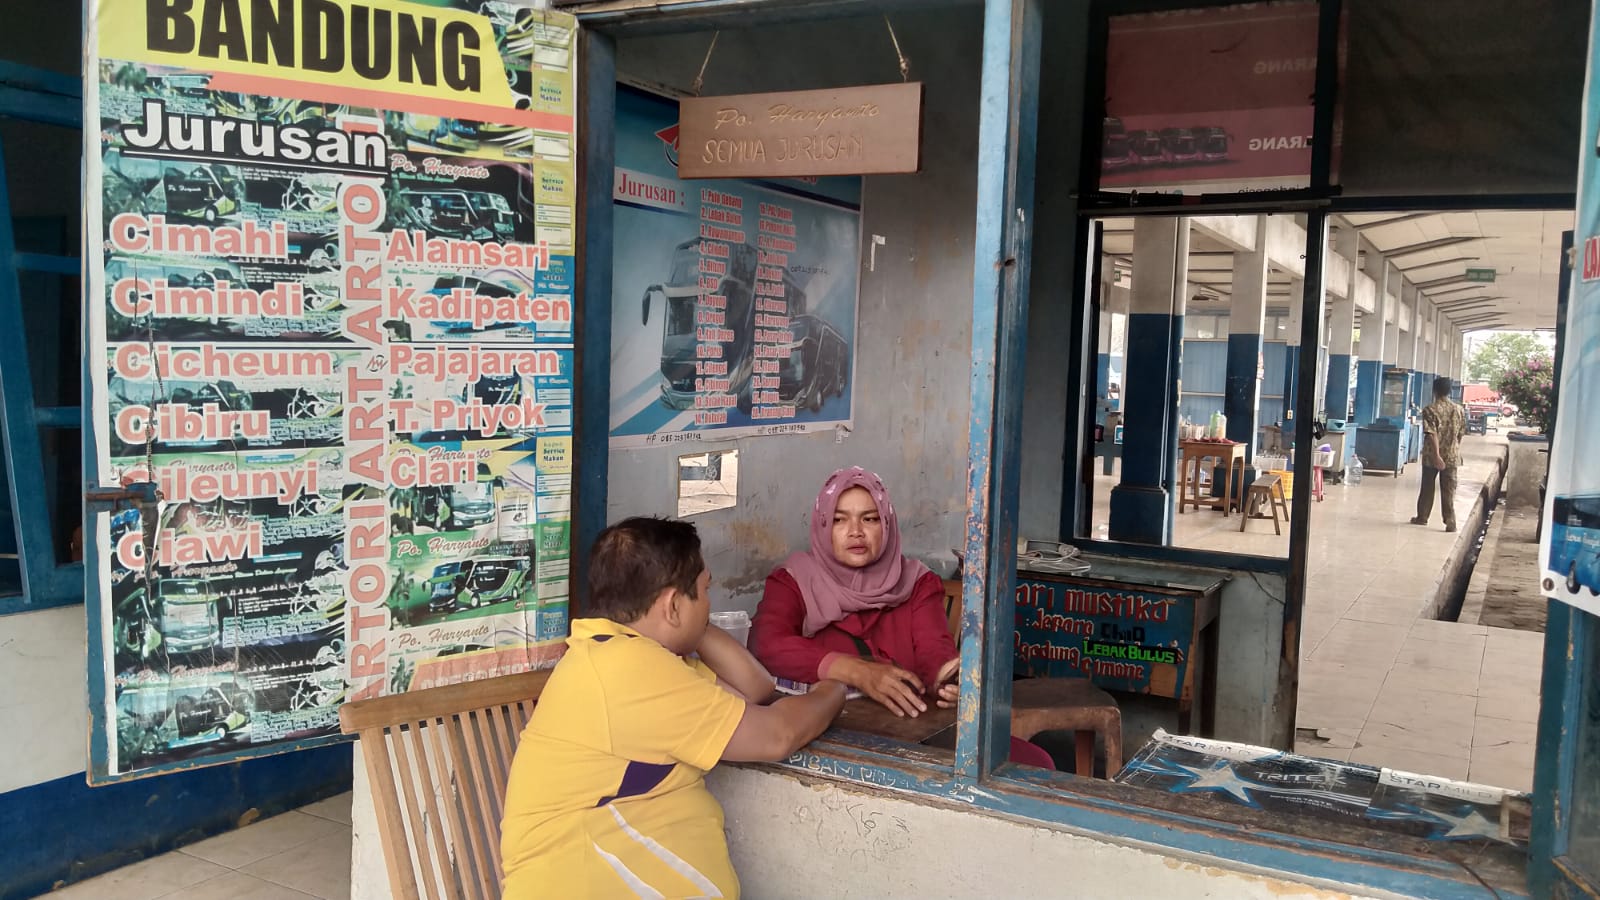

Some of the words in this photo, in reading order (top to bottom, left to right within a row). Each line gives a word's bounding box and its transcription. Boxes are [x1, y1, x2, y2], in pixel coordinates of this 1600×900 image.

[146, 0, 481, 93] BANDUNG
[122, 100, 387, 169] Jurusan
[714, 107, 752, 130] Po.
[768, 103, 880, 131] Haryanto
[390, 153, 417, 173] Po.
[422, 156, 490, 181] Haryanto
[702, 138, 767, 164] SEMUA
[776, 134, 865, 162] JURUSAN
[618, 172, 677, 204] Jurusan
[110, 213, 288, 258] Cimahi
[386, 229, 550, 270] Alamsari
[112, 277, 305, 318] Cimindi
[388, 287, 571, 329] Kadipaten
[115, 342, 332, 379] Cicheum
[389, 344, 560, 383] Pajajaran
[116, 403, 269, 443] Cibiru
[389, 401, 420, 432] T.
[433, 397, 545, 437] Priyok
[390, 453, 477, 487] Clari
[118, 523, 263, 571] Ciawi
[397, 540, 422, 557] Po.
[428, 535, 490, 553] Haryanto
[1032, 608, 1095, 636] Jepara
[1064, 588, 1170, 623] mustika
[397, 632, 421, 649] Po.
[428, 624, 490, 645] Haryanto
[1083, 640, 1127, 659] LEBAK
[1128, 645, 1175, 664] BULUS
[1390, 773, 1441, 790] STAR
[1443, 784, 1494, 799] MILD
